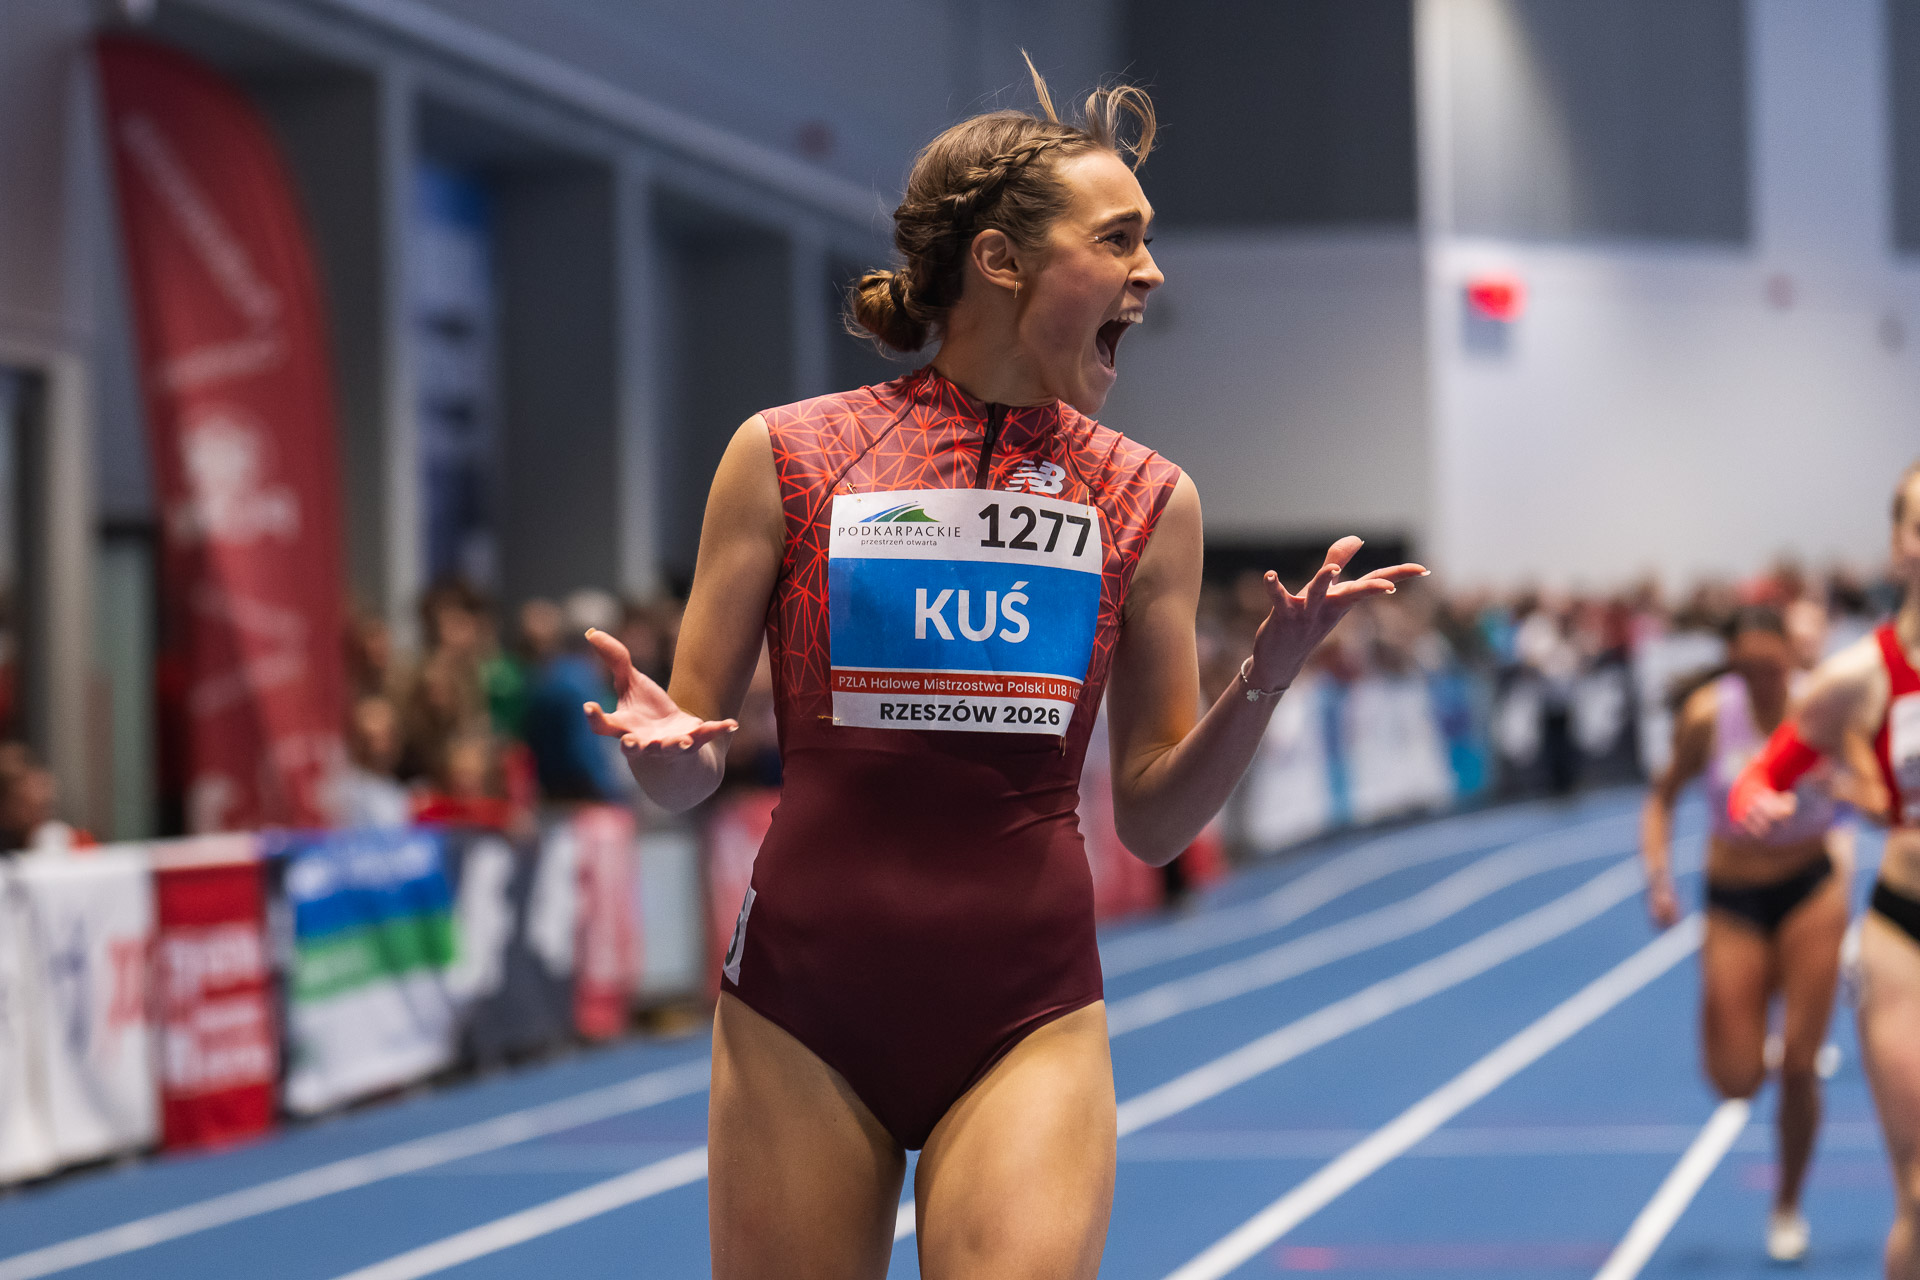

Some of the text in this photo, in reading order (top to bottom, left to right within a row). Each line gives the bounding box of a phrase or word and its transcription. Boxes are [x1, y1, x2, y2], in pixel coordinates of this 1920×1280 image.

[838, 525, 961, 538] PODKARPACKIE
[860, 538, 904, 546] przestrzeń
[978, 503, 1091, 557] 1277
[914, 580, 1030, 644] KUŚ
[838, 676, 867, 688] PZLA
[871, 677, 920, 689] Halowe
[924, 678, 1003, 692] Mistrzostwa
[1007, 681, 1045, 694] Polski
[1048, 683, 1067, 696] U18
[1068, 685, 1072, 697] i
[879, 698, 1060, 726] RZESZÓW 2026
